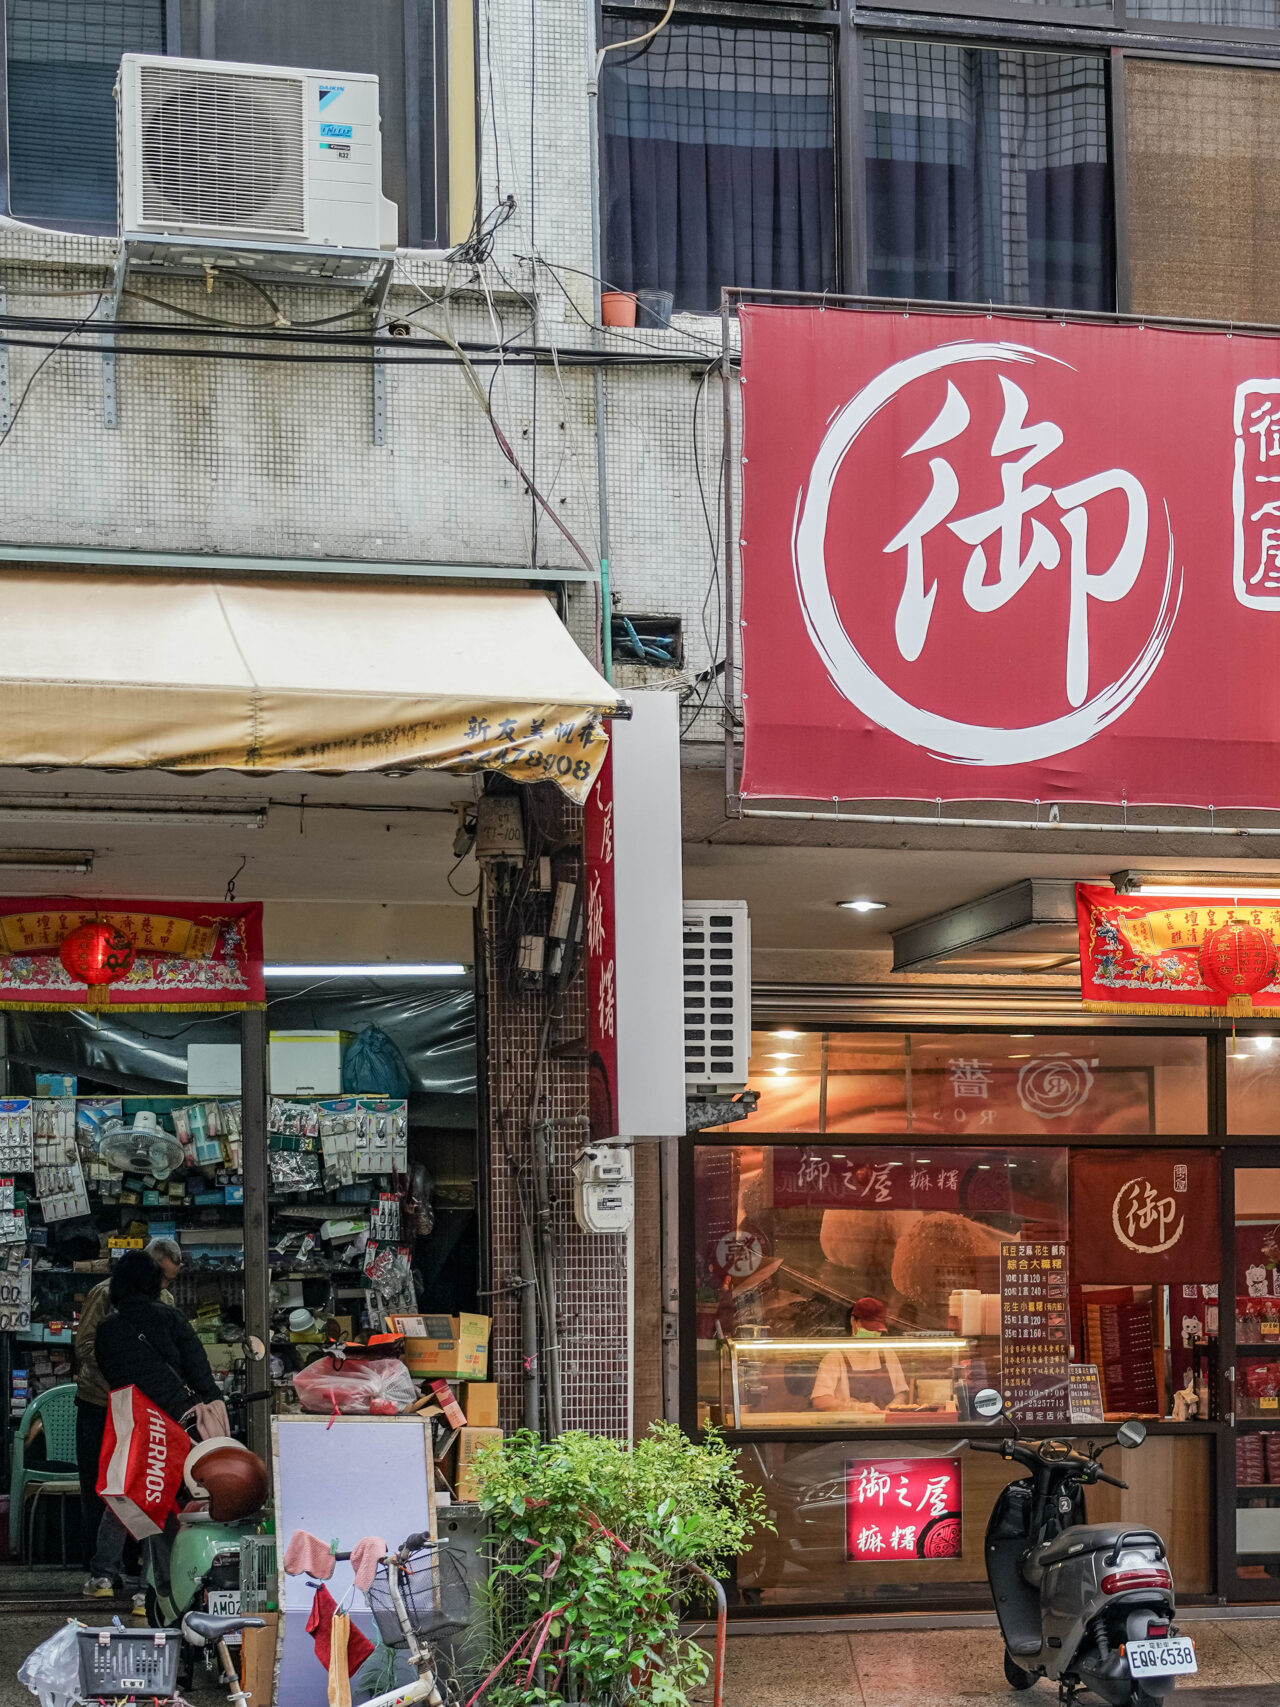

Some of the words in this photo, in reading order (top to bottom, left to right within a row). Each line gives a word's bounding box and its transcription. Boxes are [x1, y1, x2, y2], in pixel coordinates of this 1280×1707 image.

[882, 374, 1149, 708] 御
[1125, 1181, 1176, 1244] 御
[1018, 1245, 1033, 1257] 芝麻
[1035, 1245, 1049, 1256] 花生
[146, 1407, 168, 1504] THERMOS
[857, 1466, 951, 1517] 御之屋
